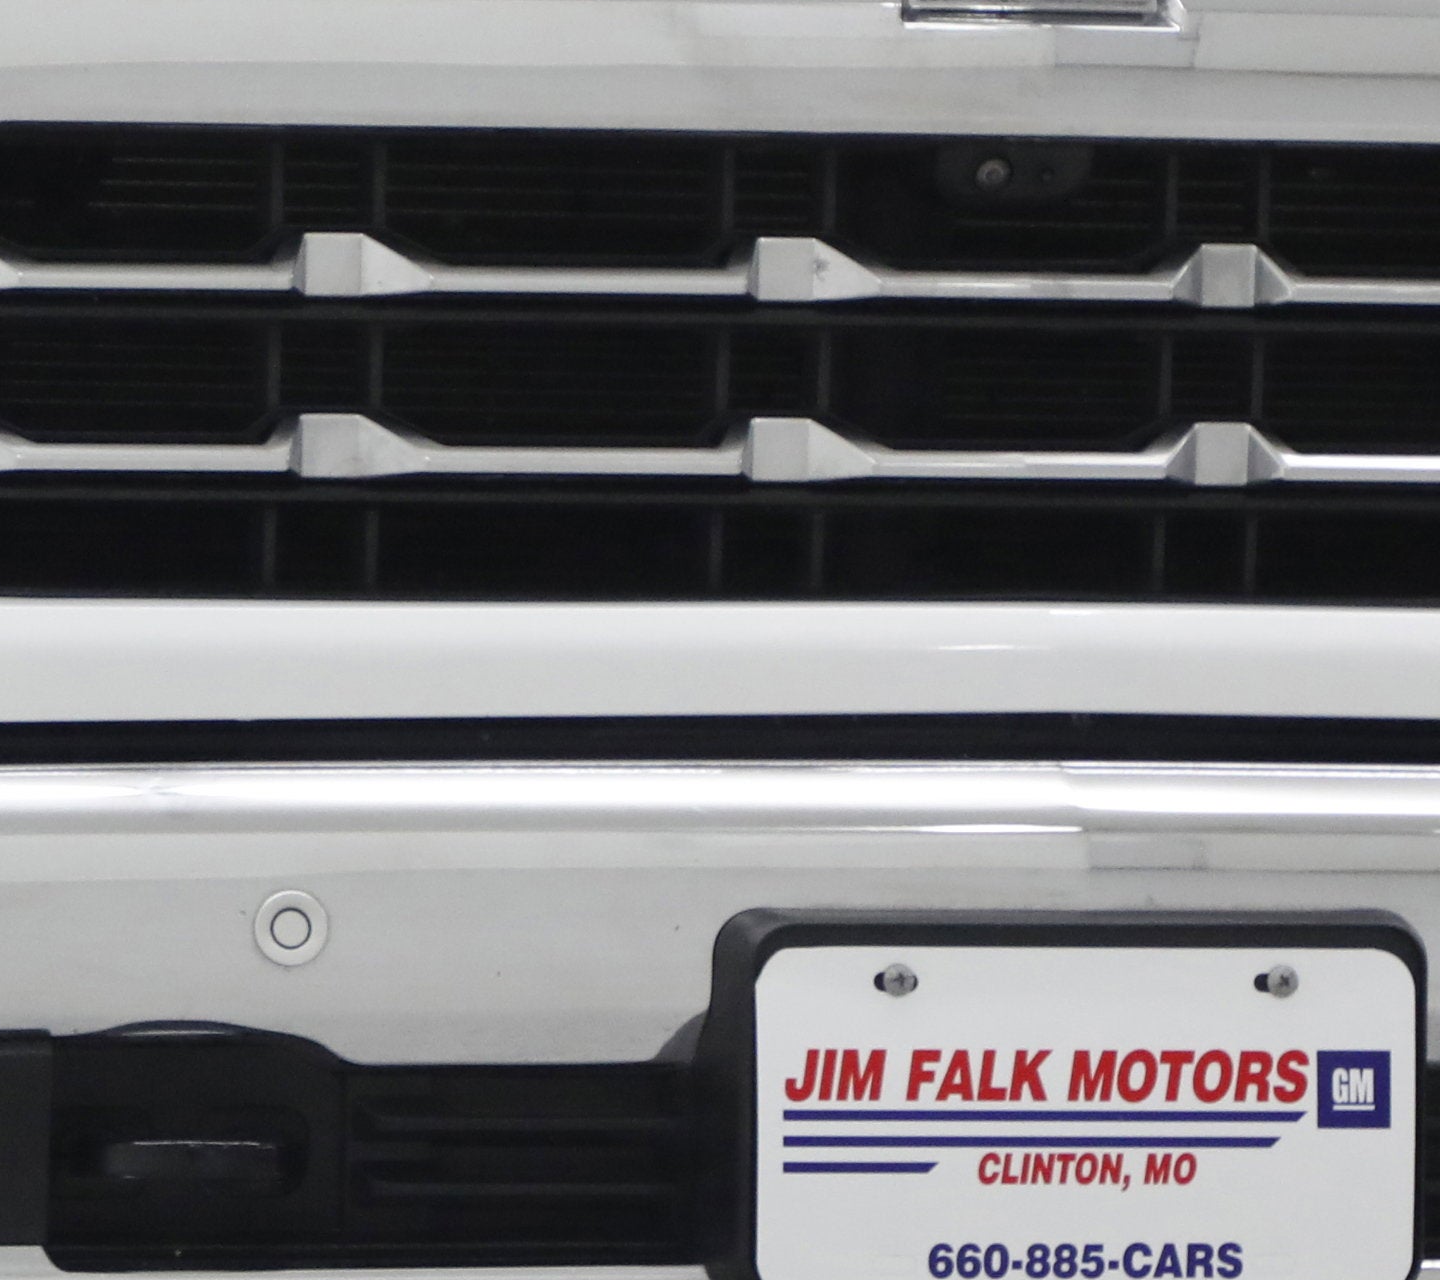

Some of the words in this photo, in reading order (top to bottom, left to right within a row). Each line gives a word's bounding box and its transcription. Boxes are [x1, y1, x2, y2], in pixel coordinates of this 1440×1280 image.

[784, 1048, 888, 1103] JIM
[905, 1048, 1053, 1103] FALK
[1067, 1048, 1310, 1104] MOTORS
[1331, 1067, 1375, 1104] GM
[977, 1151, 1130, 1192] CLINTON,
[1143, 1152, 1198, 1186] MO
[927, 1242, 1244, 1280] 660-885-CARS
